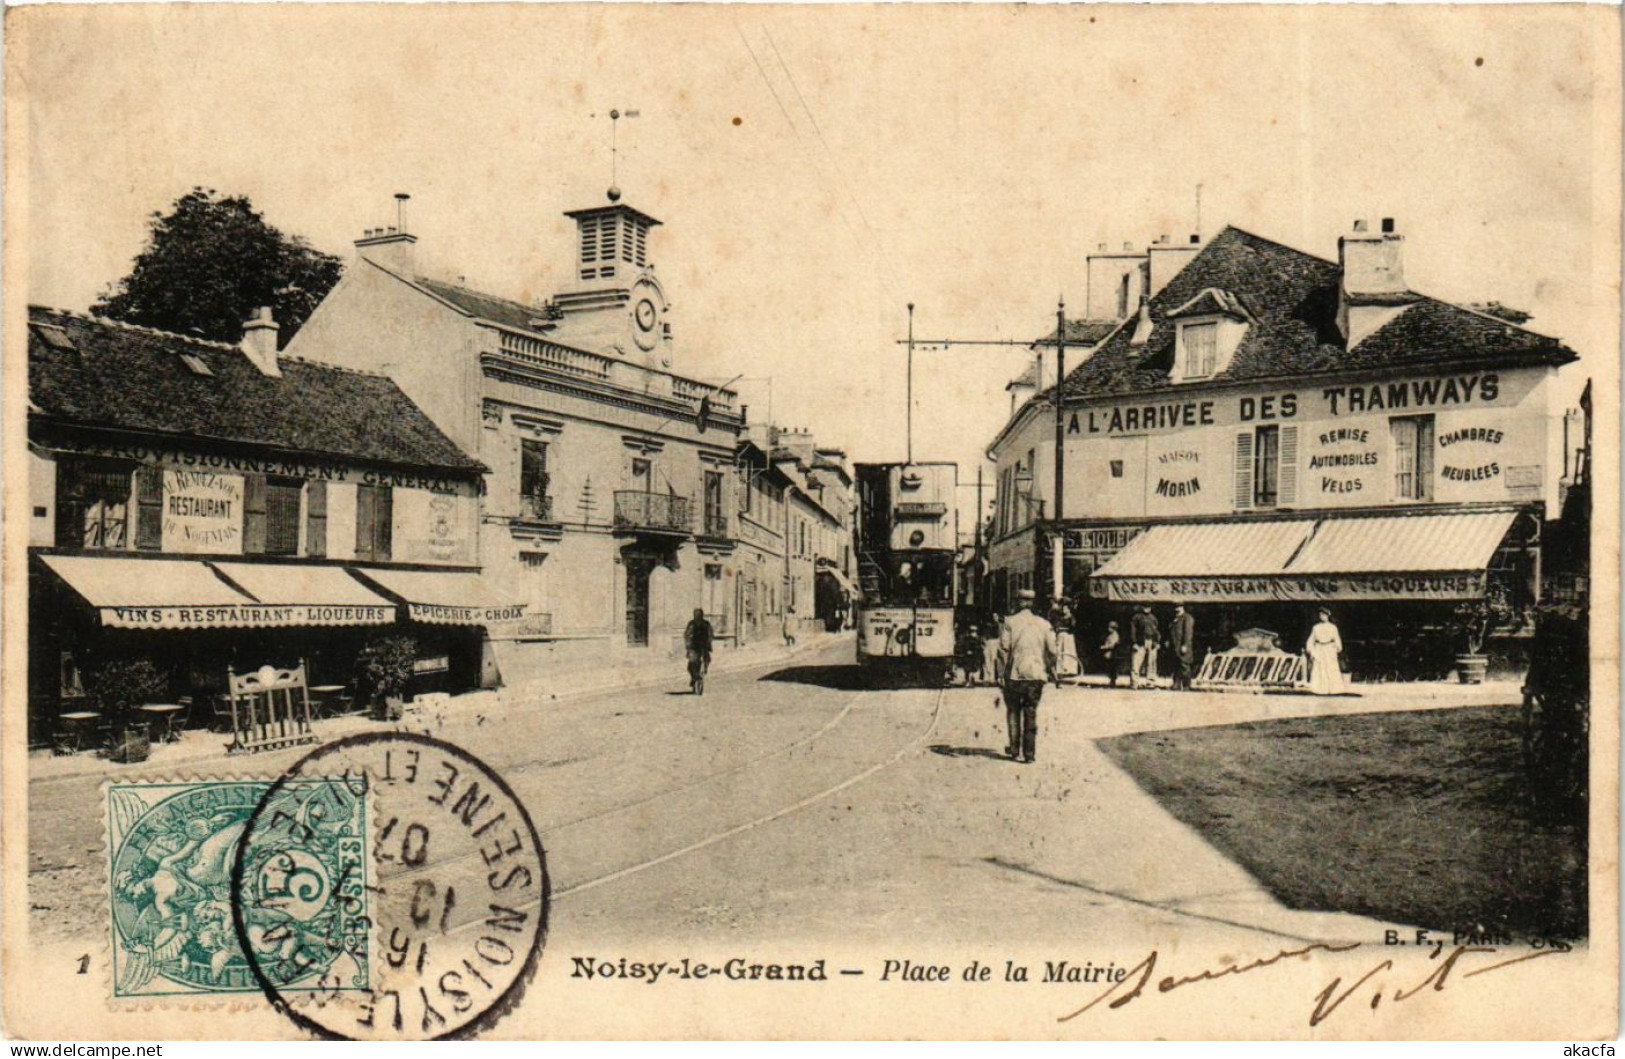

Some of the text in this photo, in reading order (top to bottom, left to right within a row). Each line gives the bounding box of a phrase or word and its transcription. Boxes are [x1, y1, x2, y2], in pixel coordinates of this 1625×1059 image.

[1067, 412, 1080, 434] A
[1240, 393, 1297, 421] DES
[1323, 374, 1500, 415] TRAMWAYS
[1319, 428, 1369, 443] REMISE
[1438, 427, 1504, 447] CHAMBRES
[1158, 451, 1199, 464] MAISON
[1309, 452, 1378, 469] AUTOMOBILES
[1441, 462, 1500, 482] MEUBLEES
[1155, 477, 1201, 498] MORIN
[1321, 476, 1363, 493] VELOS
[169, 495, 231, 519] RESTAURANT
[115, 607, 386, 623] VINS RESTAURANT LIQUEURS
[413, 605, 472, 621] EPICERIE
[485, 607, 524, 620] CHOIX
[381, 750, 420, 786] ET
[427, 760, 533, 891] SEINE
[341, 841, 363, 930] POSTES
[418, 904, 529, 1031] NOISY
[356, 987, 403, 1032] LE
